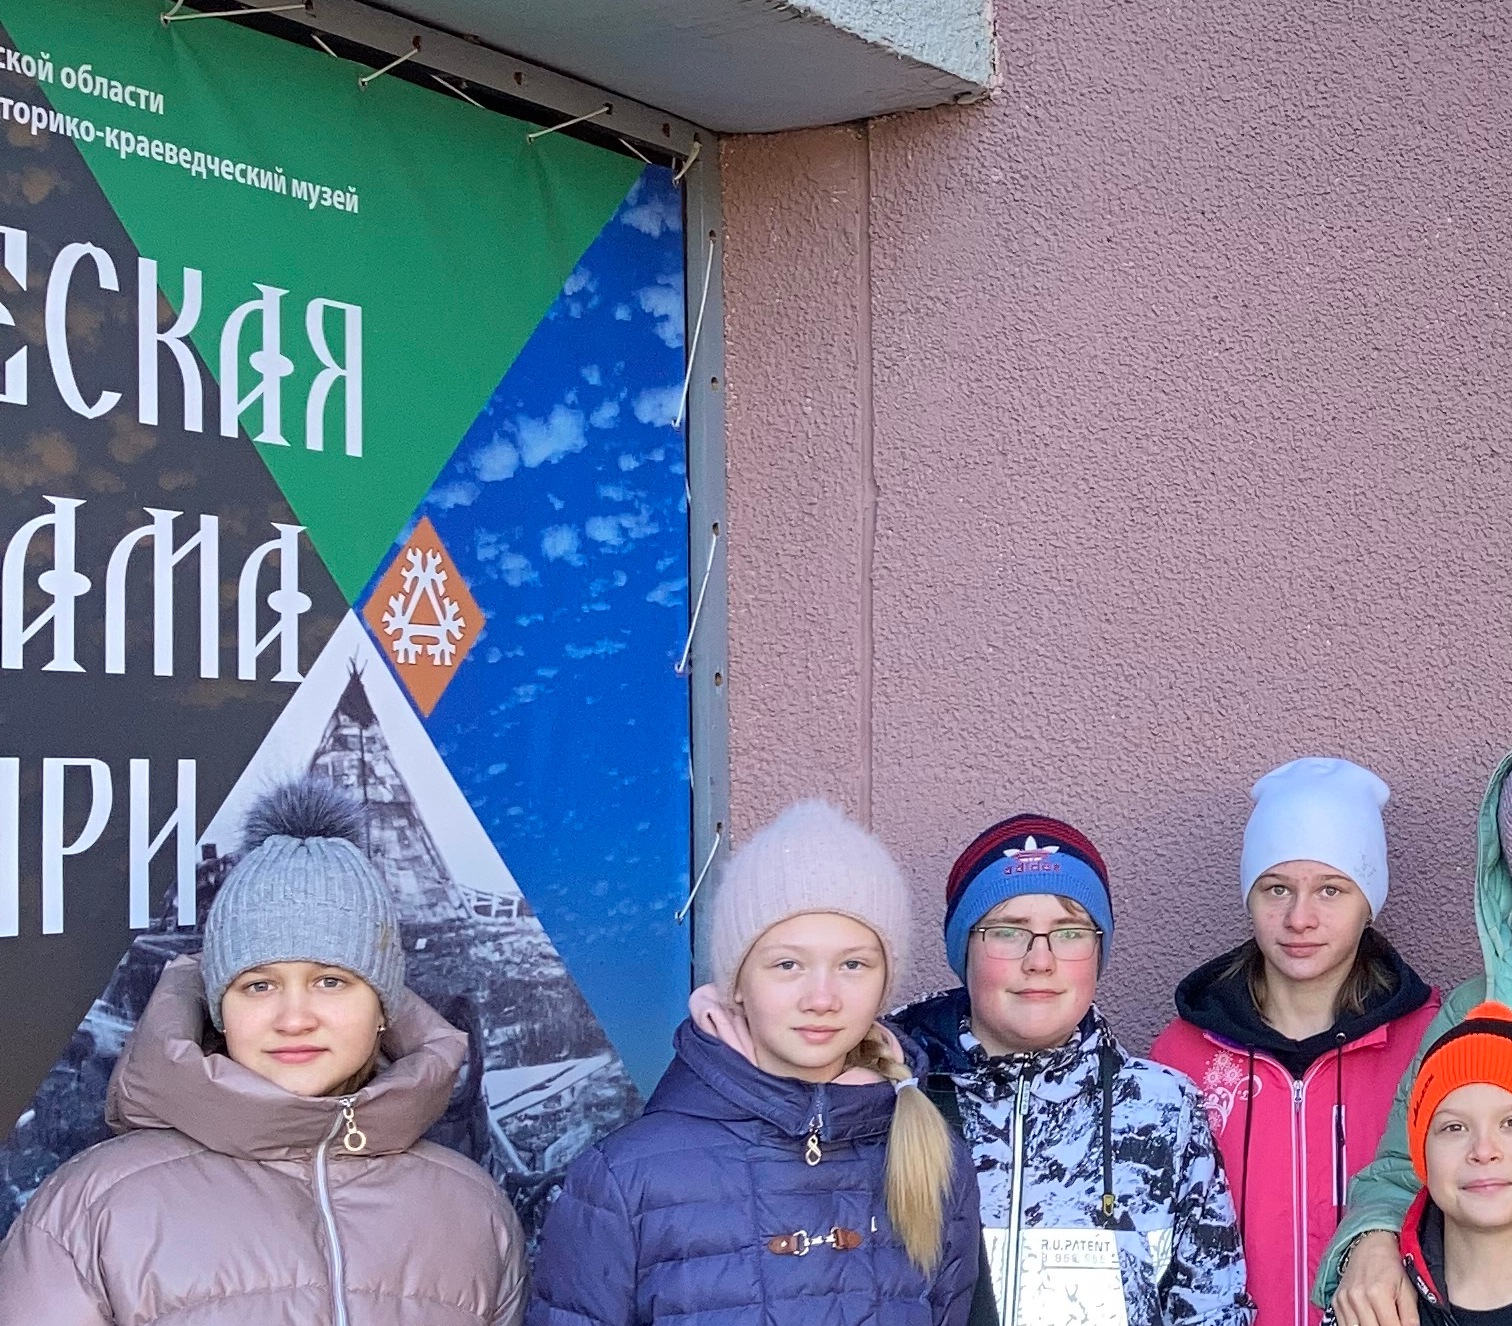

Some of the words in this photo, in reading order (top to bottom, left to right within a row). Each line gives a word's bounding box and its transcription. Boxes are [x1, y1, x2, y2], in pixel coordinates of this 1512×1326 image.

[60, 64, 164, 115] области
[0, 96, 287, 195] торико-краеведческий
[291, 186, 359, 213] музей
[1, 495, 312, 683] АМА
